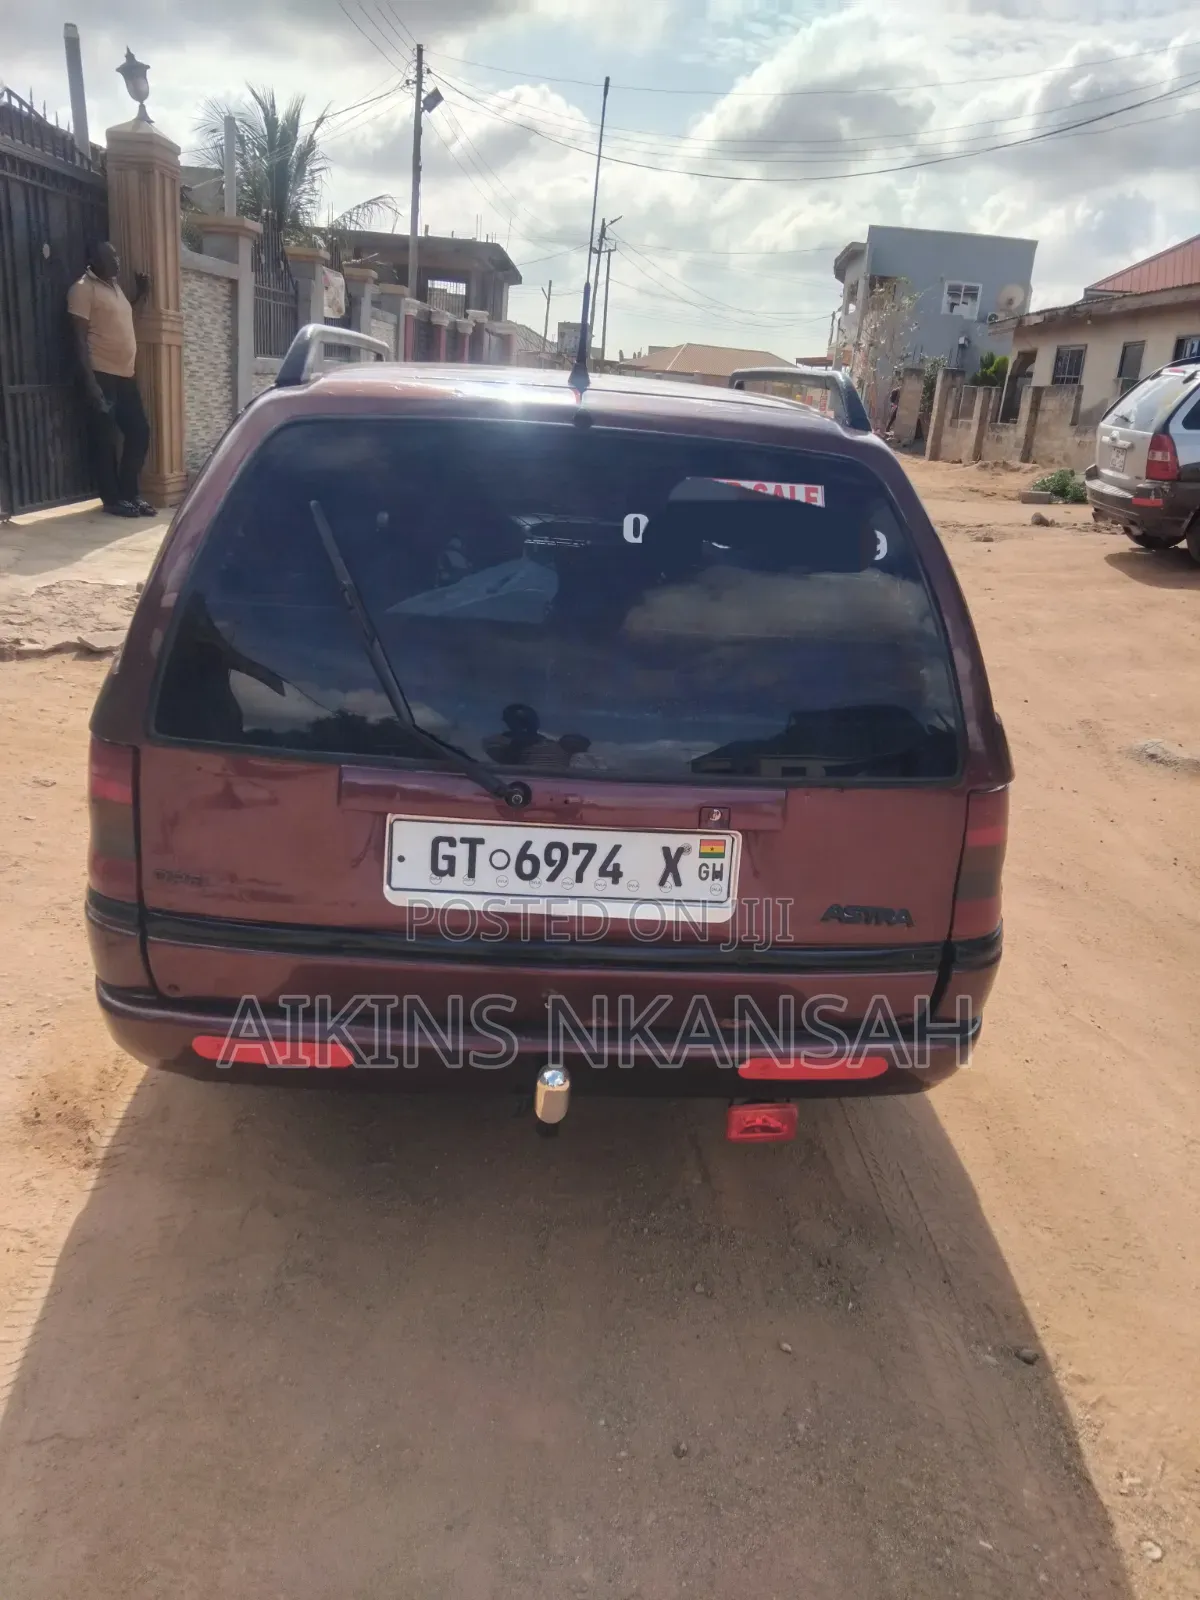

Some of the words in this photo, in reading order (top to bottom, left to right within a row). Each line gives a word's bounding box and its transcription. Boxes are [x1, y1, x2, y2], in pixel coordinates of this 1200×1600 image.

[430, 835, 485, 879] GT
[514, 840, 624, 885] 6974
[658, 846, 685, 888] X
[820, 904, 915, 928] ASTRA
